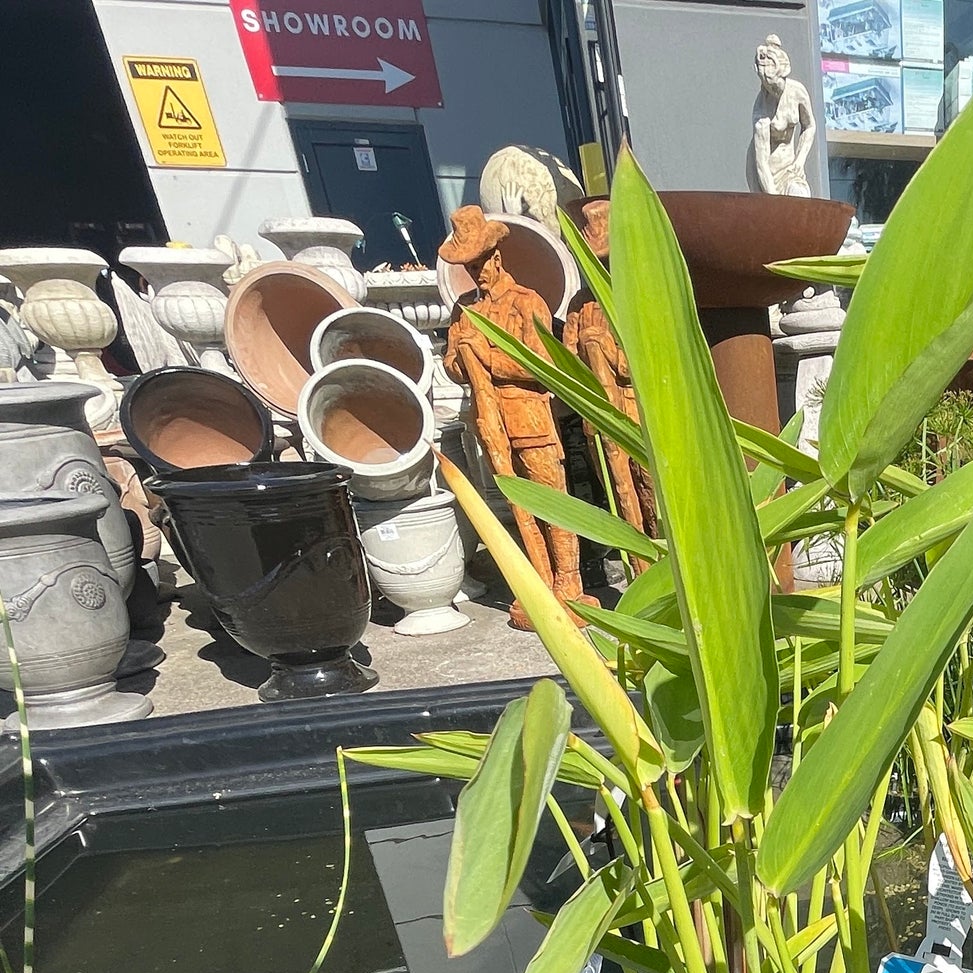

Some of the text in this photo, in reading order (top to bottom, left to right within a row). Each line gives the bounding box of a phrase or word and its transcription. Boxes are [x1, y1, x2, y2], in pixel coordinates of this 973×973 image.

[240, 9, 422, 42] SHOWROOM
[134, 63, 192, 78] WARNING
[162, 133, 204, 142] WATCH OUT
[168, 141, 202, 149] FORKLIFT
[157, 149, 219, 159] OPERATING AREA
